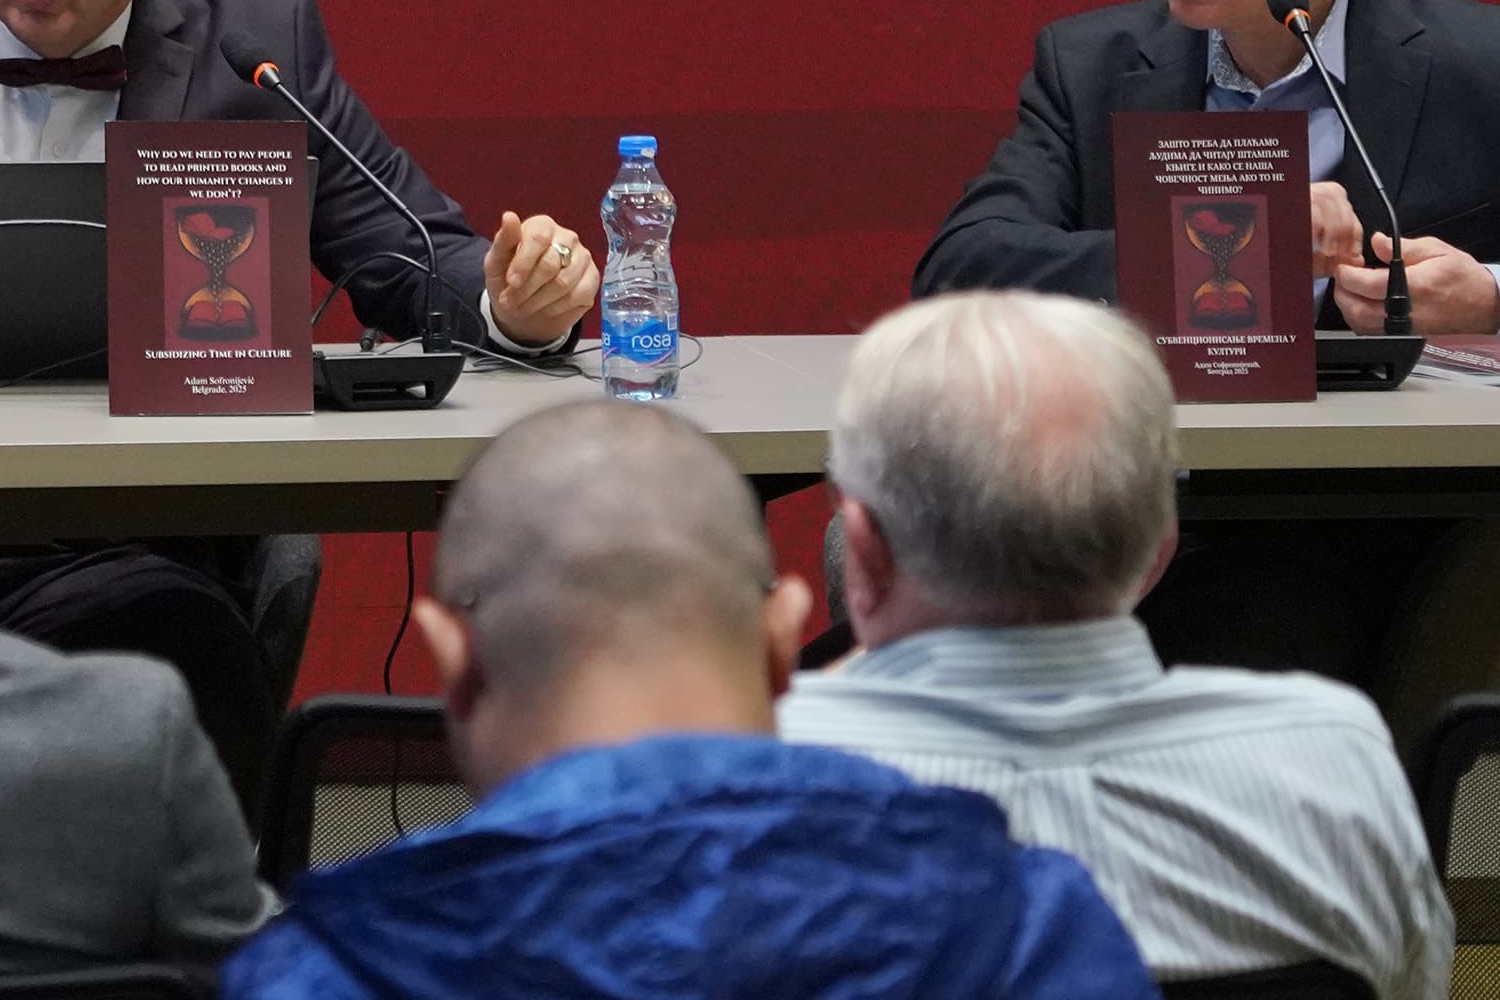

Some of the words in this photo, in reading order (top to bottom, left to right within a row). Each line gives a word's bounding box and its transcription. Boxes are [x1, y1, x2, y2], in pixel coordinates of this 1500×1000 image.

[136, 149, 161, 159] WHY
[162, 150, 178, 159] DO
[179, 150, 194, 159] WE
[195, 150, 222, 159] NEED
[223, 150, 238, 159] TO
[238, 150, 256, 159] PAY
[257, 150, 293, 159] PEOPLE
[144, 163, 158, 172] TO
[159, 163, 186, 172] READ
[186, 163, 229, 172] PRINTED
[230, 163, 264, 173] BOOKS
[264, 163, 287, 172] AND
[136, 176, 160, 185] HOW
[161, 176, 184, 185] OUR
[184, 176, 237, 186] HUMANITY
[237, 176, 283, 186] CHANGES
[189, 190, 205, 199] WE
[631, 334, 672, 349] rosa
[145, 349, 208, 360] SUBSIDIZING
[208, 348, 233, 359] TIME
[234, 349, 247, 359] IN
[247, 348, 293, 359] CULTURE
[184, 377, 208, 385] Adam
[228, 385, 248, 394] 2025
